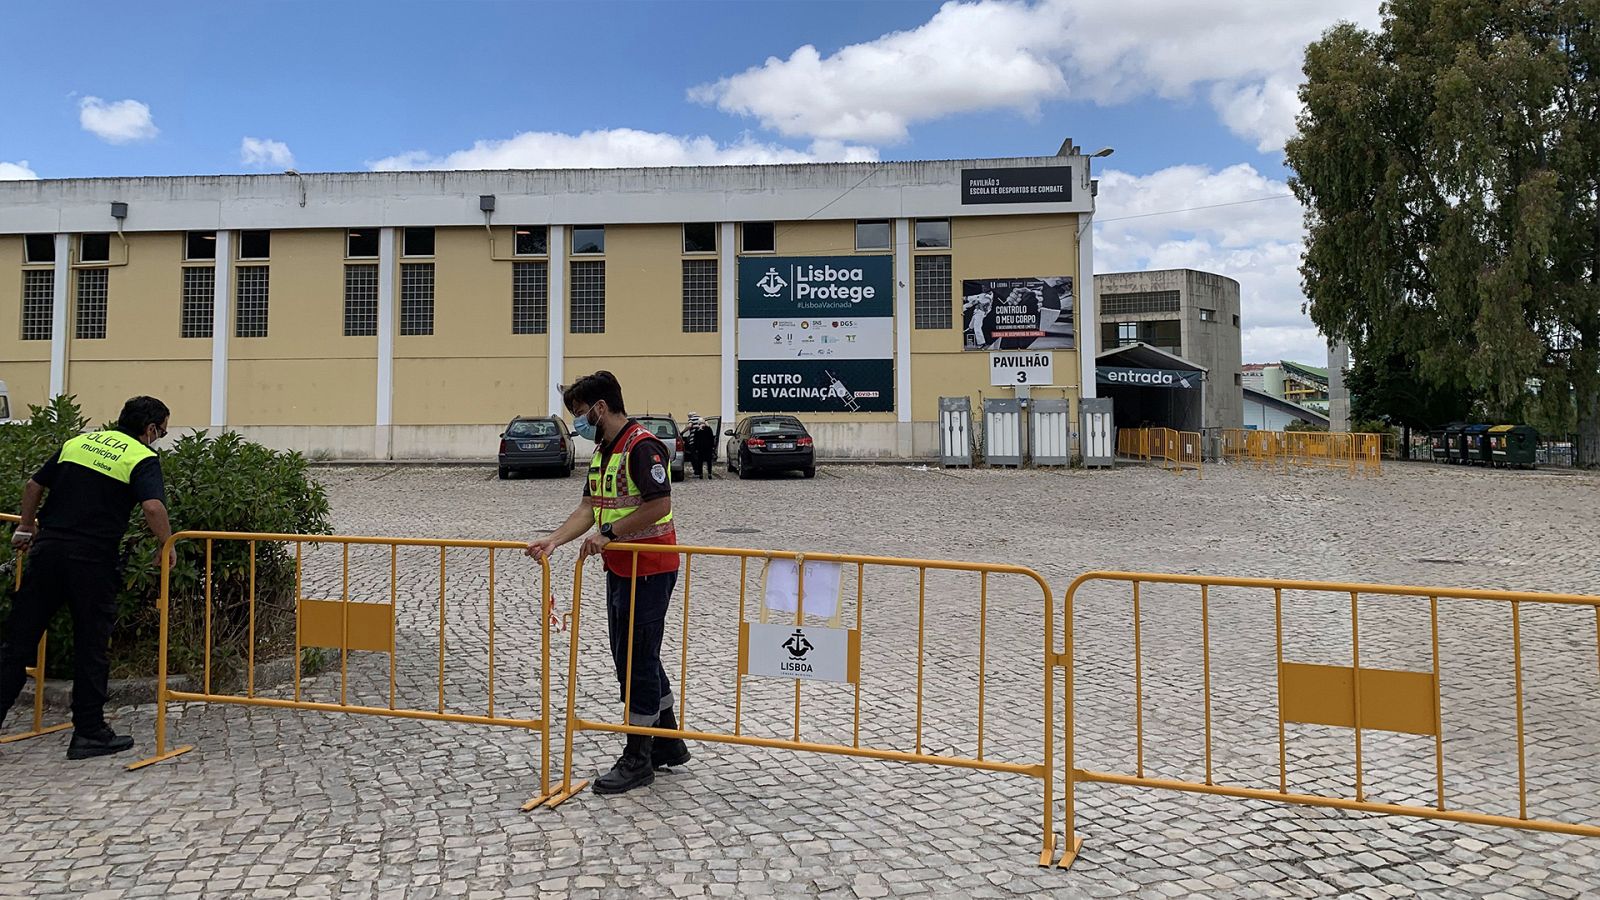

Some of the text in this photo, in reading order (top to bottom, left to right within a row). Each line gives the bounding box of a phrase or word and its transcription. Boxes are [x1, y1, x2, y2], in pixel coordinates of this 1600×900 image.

[970, 178, 995, 186] PAVILHÃO
[797, 264, 862, 281] Lisboa
[797, 283, 875, 303] Protege
[996, 305, 1027, 314] CONTROLO
[996, 315, 1036, 324] O MEU CORPO
[994, 354, 1049, 367] PAVILHÃO
[752, 374, 802, 384] CENTRO
[1017, 371, 1027, 383] 3
[1108, 370, 1172, 384] entrada
[752, 385, 846, 400] DE VACINAÇÃO
[84, 433, 128, 453] OLÍCIA
[81, 443, 121, 462] municipal
[92, 459, 112, 471] Lisboa
[780, 662, 813, 672] LISBOA
